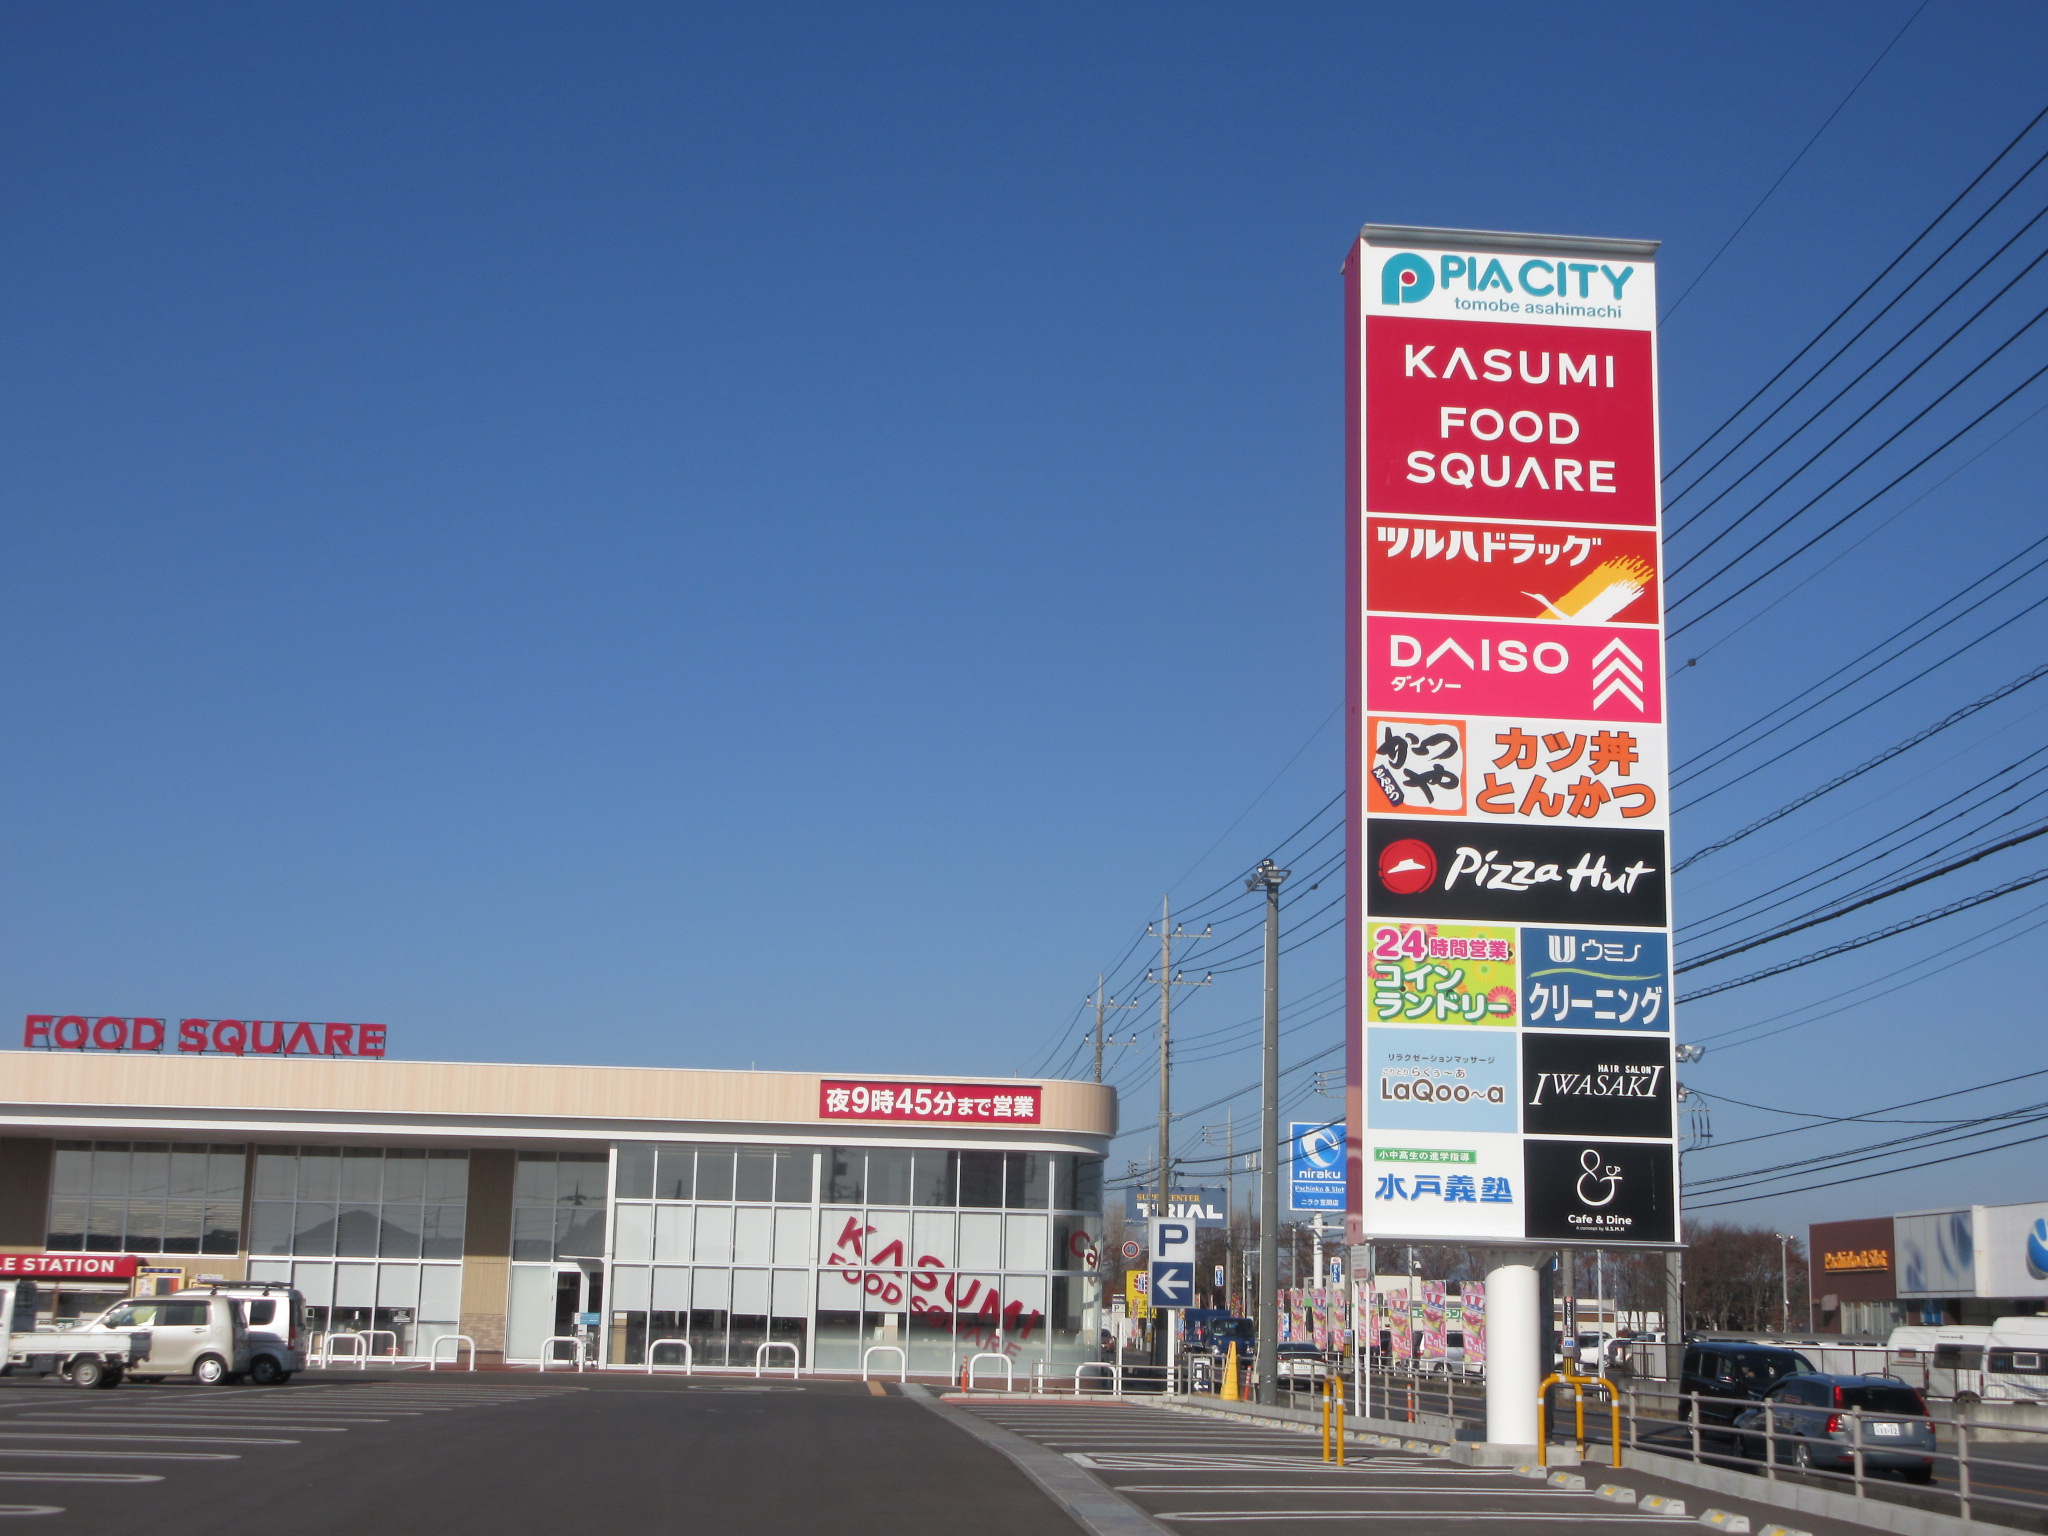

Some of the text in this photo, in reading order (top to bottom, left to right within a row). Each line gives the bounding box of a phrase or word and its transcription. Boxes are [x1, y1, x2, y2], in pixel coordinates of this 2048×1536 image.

[1440, 255, 1634, 300] PIA CITY
[1454, 297, 1622, 318] tomobe asahimachi
[1405, 344, 1615, 388] KASUMI
[1440, 406, 1580, 445] FOOD
[1406, 450, 1616, 493] SQUARE
[1377, 526, 1602, 566] ツルハドラッグ
[1390, 634, 1570, 675] DAISO
[1391, 675, 1462, 693] ダイソー
[1492, 727, 1639, 776] カツ丼
[1475, 772, 1656, 818] とんかつ
[1444, 846, 1656, 894] Pizza Hut
[1374, 964, 1464, 992] コイン
[1374, 991, 1511, 1021] ランドリー
[1529, 983, 1663, 1024] クリーニング
[23, 1014, 388, 1058] FOOD SQUARE
[1388, 1053, 1496, 1064] リラクゼーションマッサージ
[1598, 1064, 1652, 1074] HAIR SALON
[1529, 1065, 1665, 1106] IWASAKI
[826, 1086, 1034, 1118] 夜9時45分まで営業
[1379, 1150, 1470, 1162] 小中高生の進学指導
[1299, 1167, 1341, 1179] niraku
[1375, 1173, 1514, 1204] 水戸義塾
[1568, 1214, 1632, 1225] Cafe & Dine
[1126, 1245, 1136, 1253] 40
[1158, 1224, 1189, 1257] P
[23, 1257, 115, 1273] STATION
